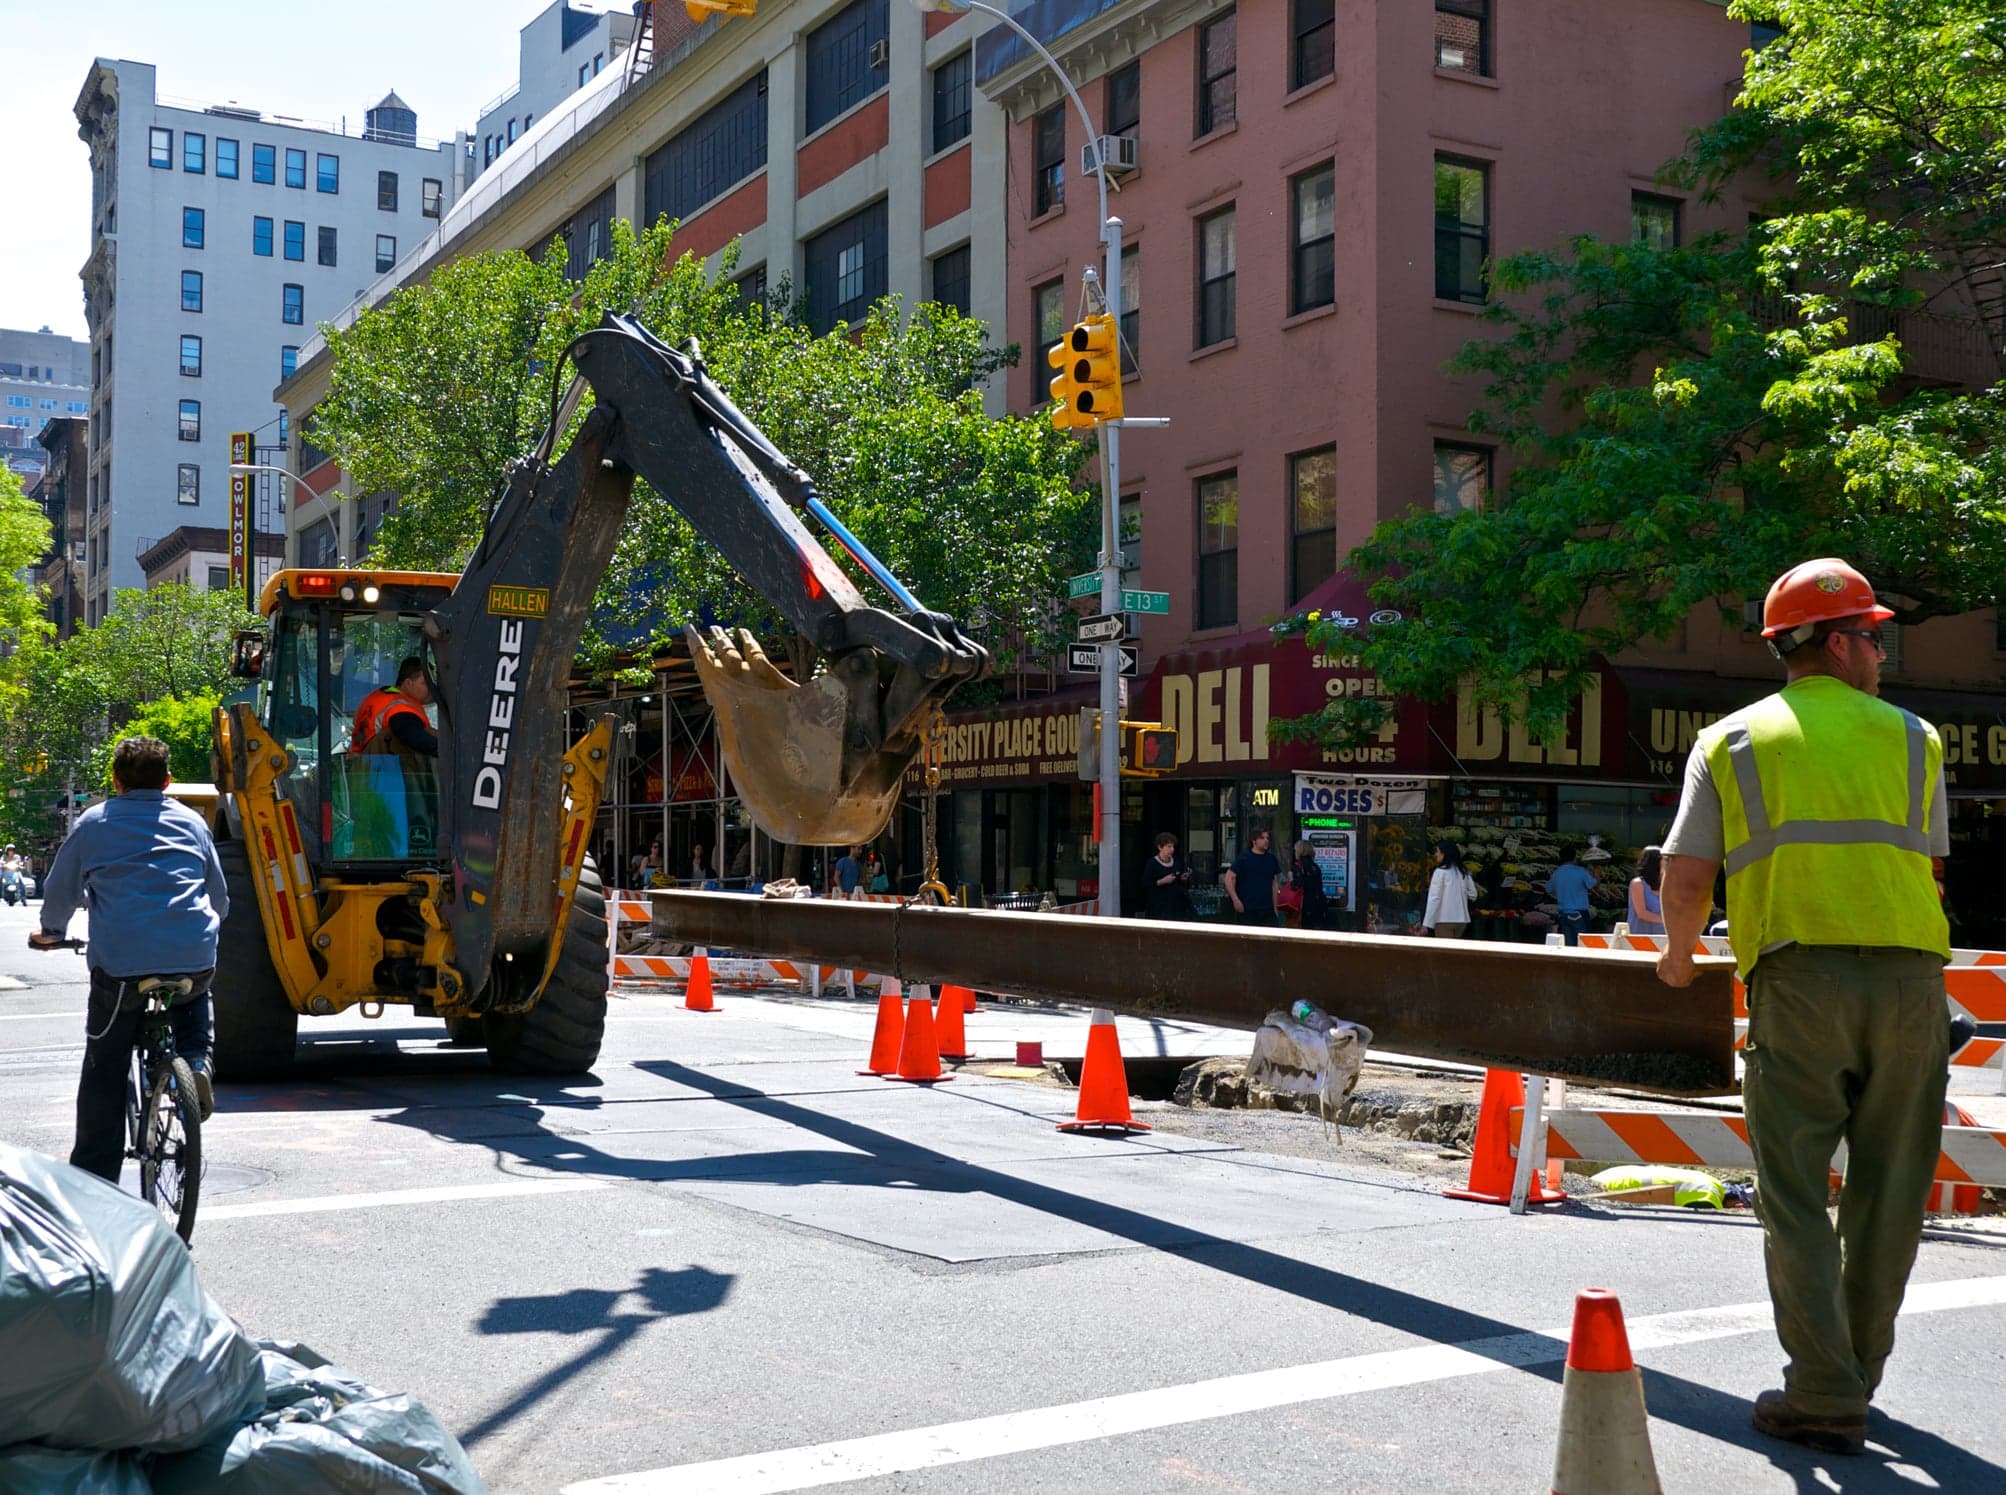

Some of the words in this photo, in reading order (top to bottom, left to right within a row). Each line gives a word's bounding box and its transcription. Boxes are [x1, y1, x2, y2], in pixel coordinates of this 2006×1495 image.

[234, 441, 245, 453] 42
[233, 479, 244, 556] OWLMOR
[491, 591, 546, 612] HALLEN
[1125, 593, 1133, 609] E
[1137, 594, 1151, 610] 13
[1084, 625, 1097, 637] ONE
[1104, 621, 1118, 633] WAY
[473, 619, 523, 810] DEERE
[1162, 663, 1270, 764] DELI
[994, 717, 1042, 758] PLACE
[1322, 747, 1396, 763] HOURS
[907, 770, 920, 782] 116
[1040, 762, 1053, 774] FREE
[1650, 759, 1674, 774] 116
[1306, 776, 1347, 786] Two
[1252, 789, 1279, 806] ATM
[1301, 787, 1372, 813] ROSES
